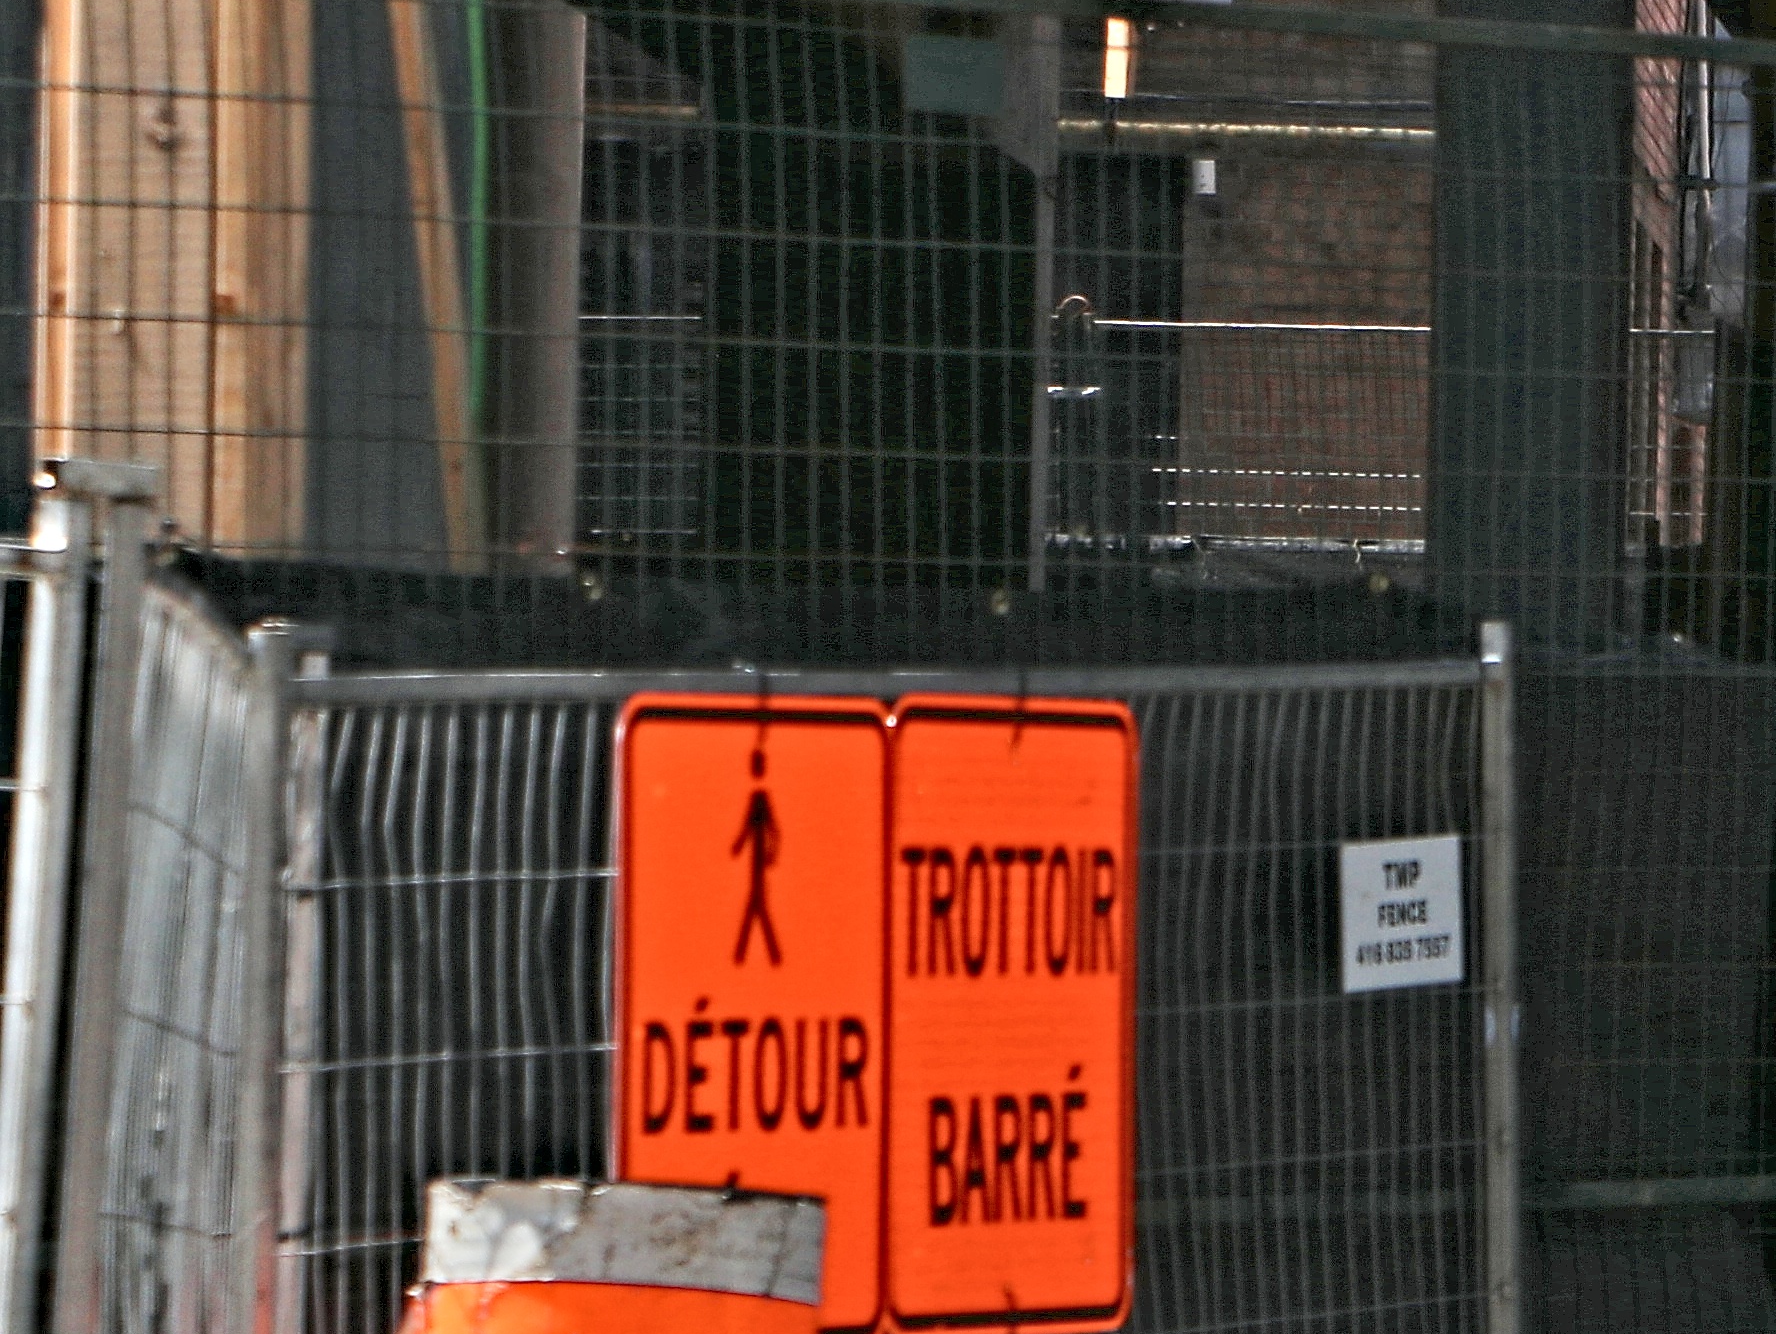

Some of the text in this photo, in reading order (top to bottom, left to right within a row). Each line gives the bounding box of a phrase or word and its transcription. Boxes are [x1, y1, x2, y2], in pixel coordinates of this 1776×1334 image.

[899, 846, 1116, 978] TROTTOIR
[1377, 899, 1428, 928] FENCE
[641, 997, 870, 1135] DÉTOUR
[927, 1063, 1089, 1228] BARRÉ
